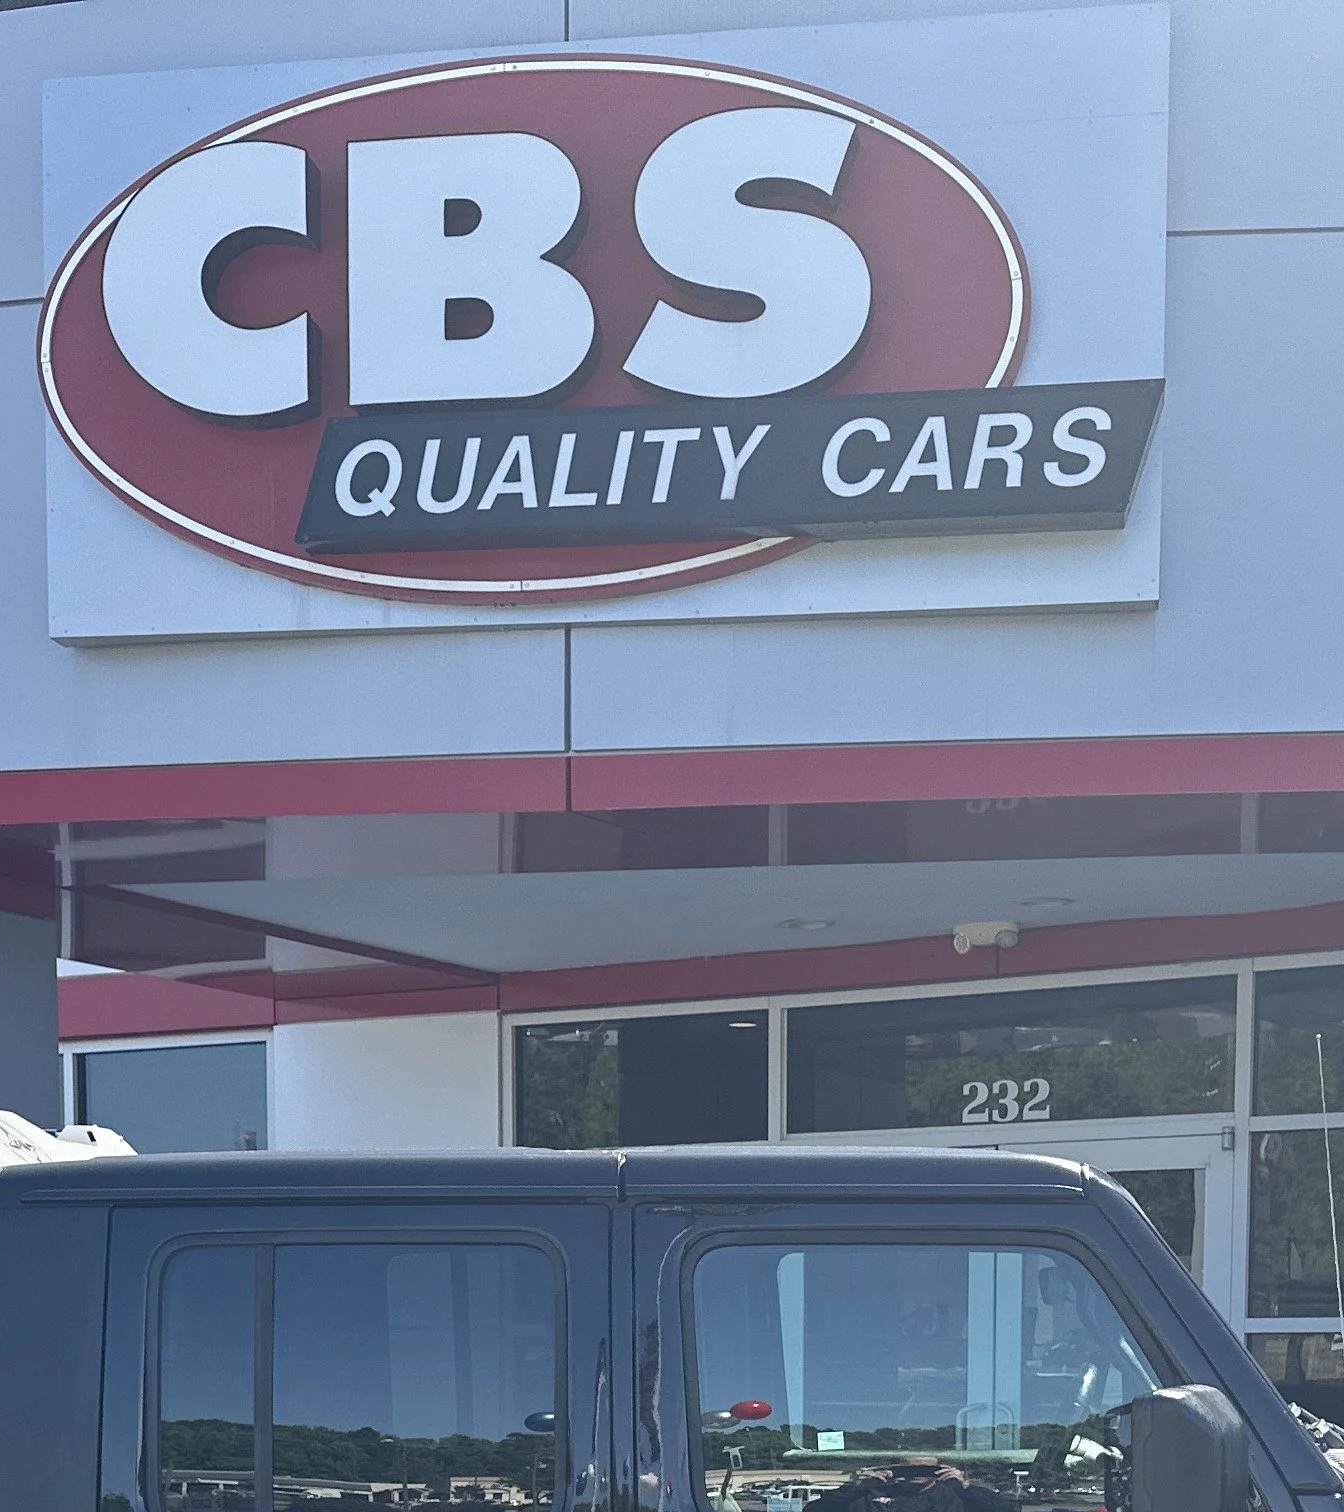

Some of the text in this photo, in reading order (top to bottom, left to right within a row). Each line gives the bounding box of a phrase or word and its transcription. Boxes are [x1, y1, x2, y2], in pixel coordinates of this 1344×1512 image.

[102, 107, 872, 416] CBS
[334, 405, 1113, 517] QUALITY CARS
[961, 1078, 1051, 1123] 232
